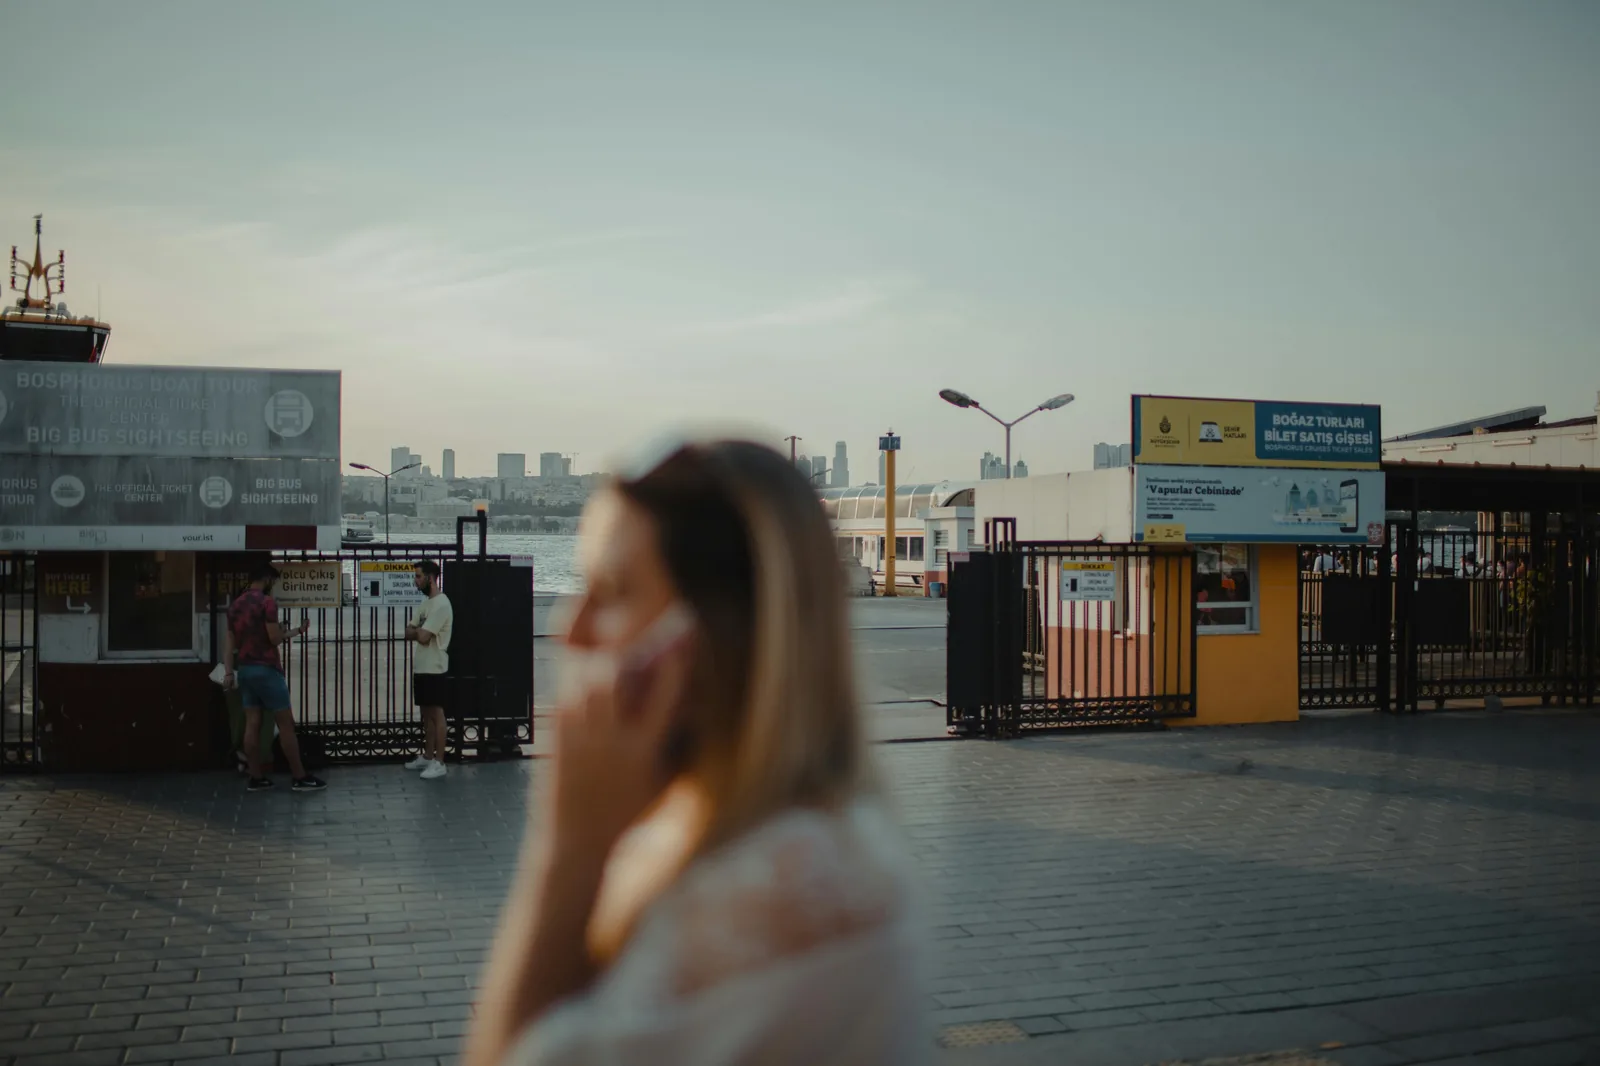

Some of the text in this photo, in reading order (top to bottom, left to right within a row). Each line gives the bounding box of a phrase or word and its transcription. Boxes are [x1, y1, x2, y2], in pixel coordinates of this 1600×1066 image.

[17, 372, 143, 391] BOSPHORUS
[1273, 412, 1365, 428] BOĞAZ TURLARI
[27, 426, 248, 447] BIG BUS SIGHTSEEING
[1264, 428, 1373, 446] BİLET SATIŞ GİŞESİ
[0, 478, 38, 490] ORUS
[95, 484, 194, 494] THE OFFICIAL TICKET
[256, 478, 302, 489] BIG BUS
[0, 494, 35, 506] TOUR
[124, 494, 164, 504] CENTER
[241, 493, 318, 504] SIGHTSEEING
[309, 569, 336, 580] Çıkış
[45, 580, 92, 596] HERE
[283, 581, 329, 591] Girilmez
